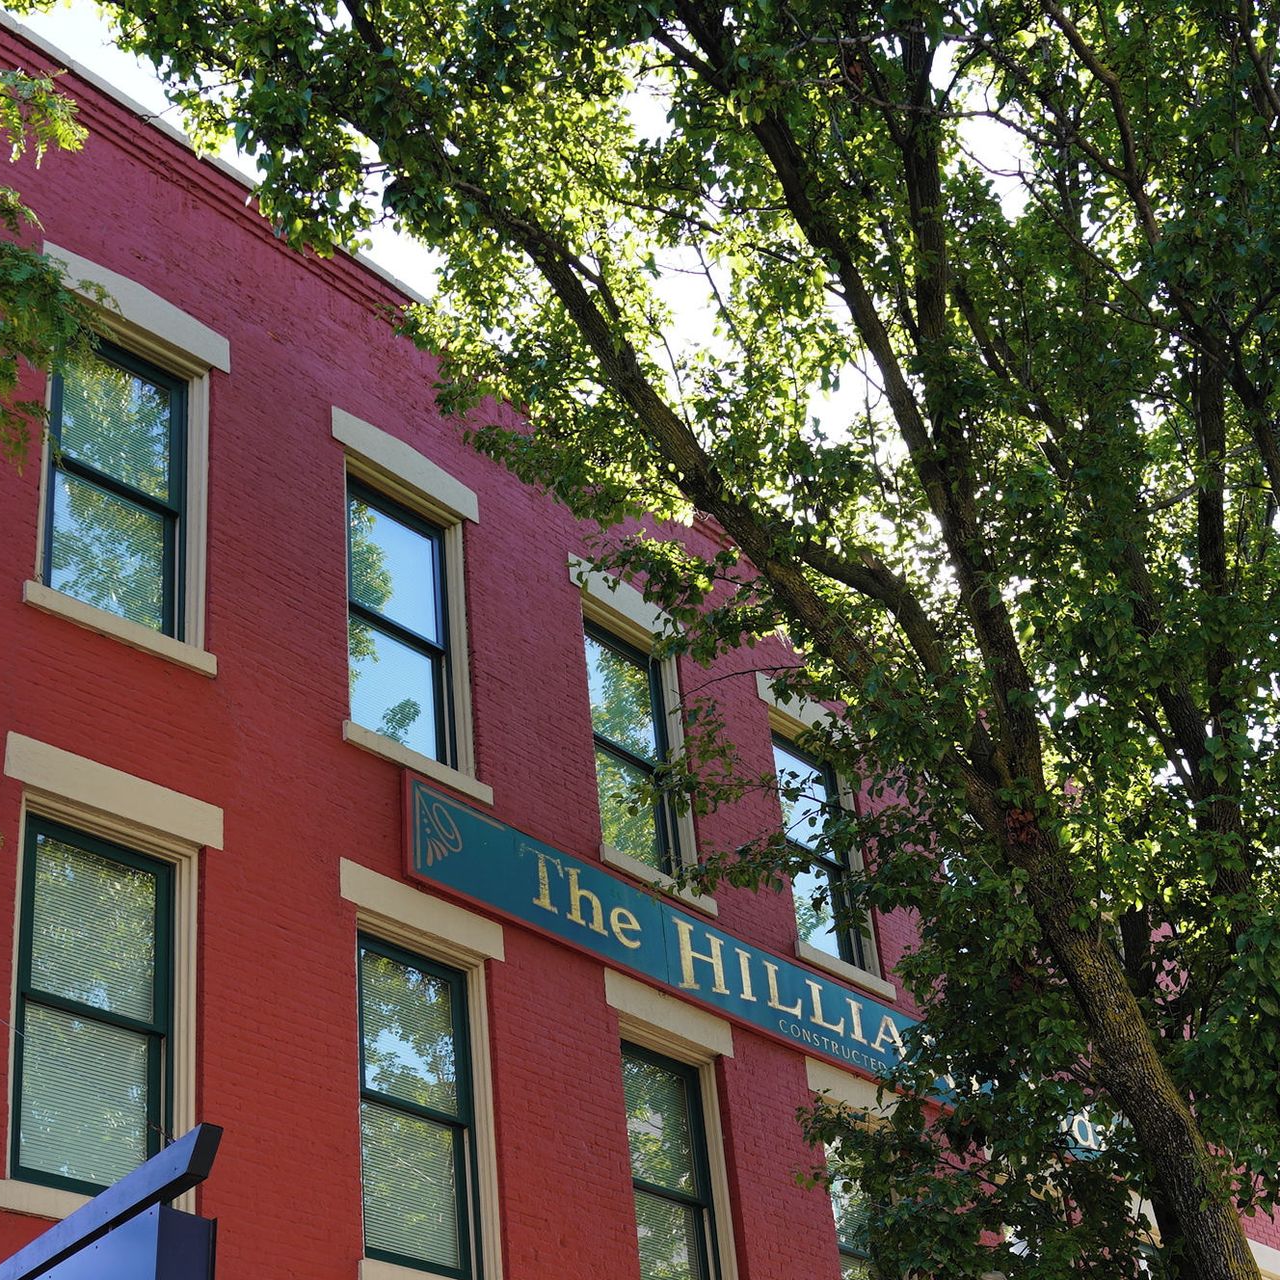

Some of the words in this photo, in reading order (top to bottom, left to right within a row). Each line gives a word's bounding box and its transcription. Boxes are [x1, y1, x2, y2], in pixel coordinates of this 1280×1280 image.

[519, 844, 643, 950] The
[670, 915, 918, 1064] HILLIA
[778, 1018, 889, 1073] CONSTRUCTED
